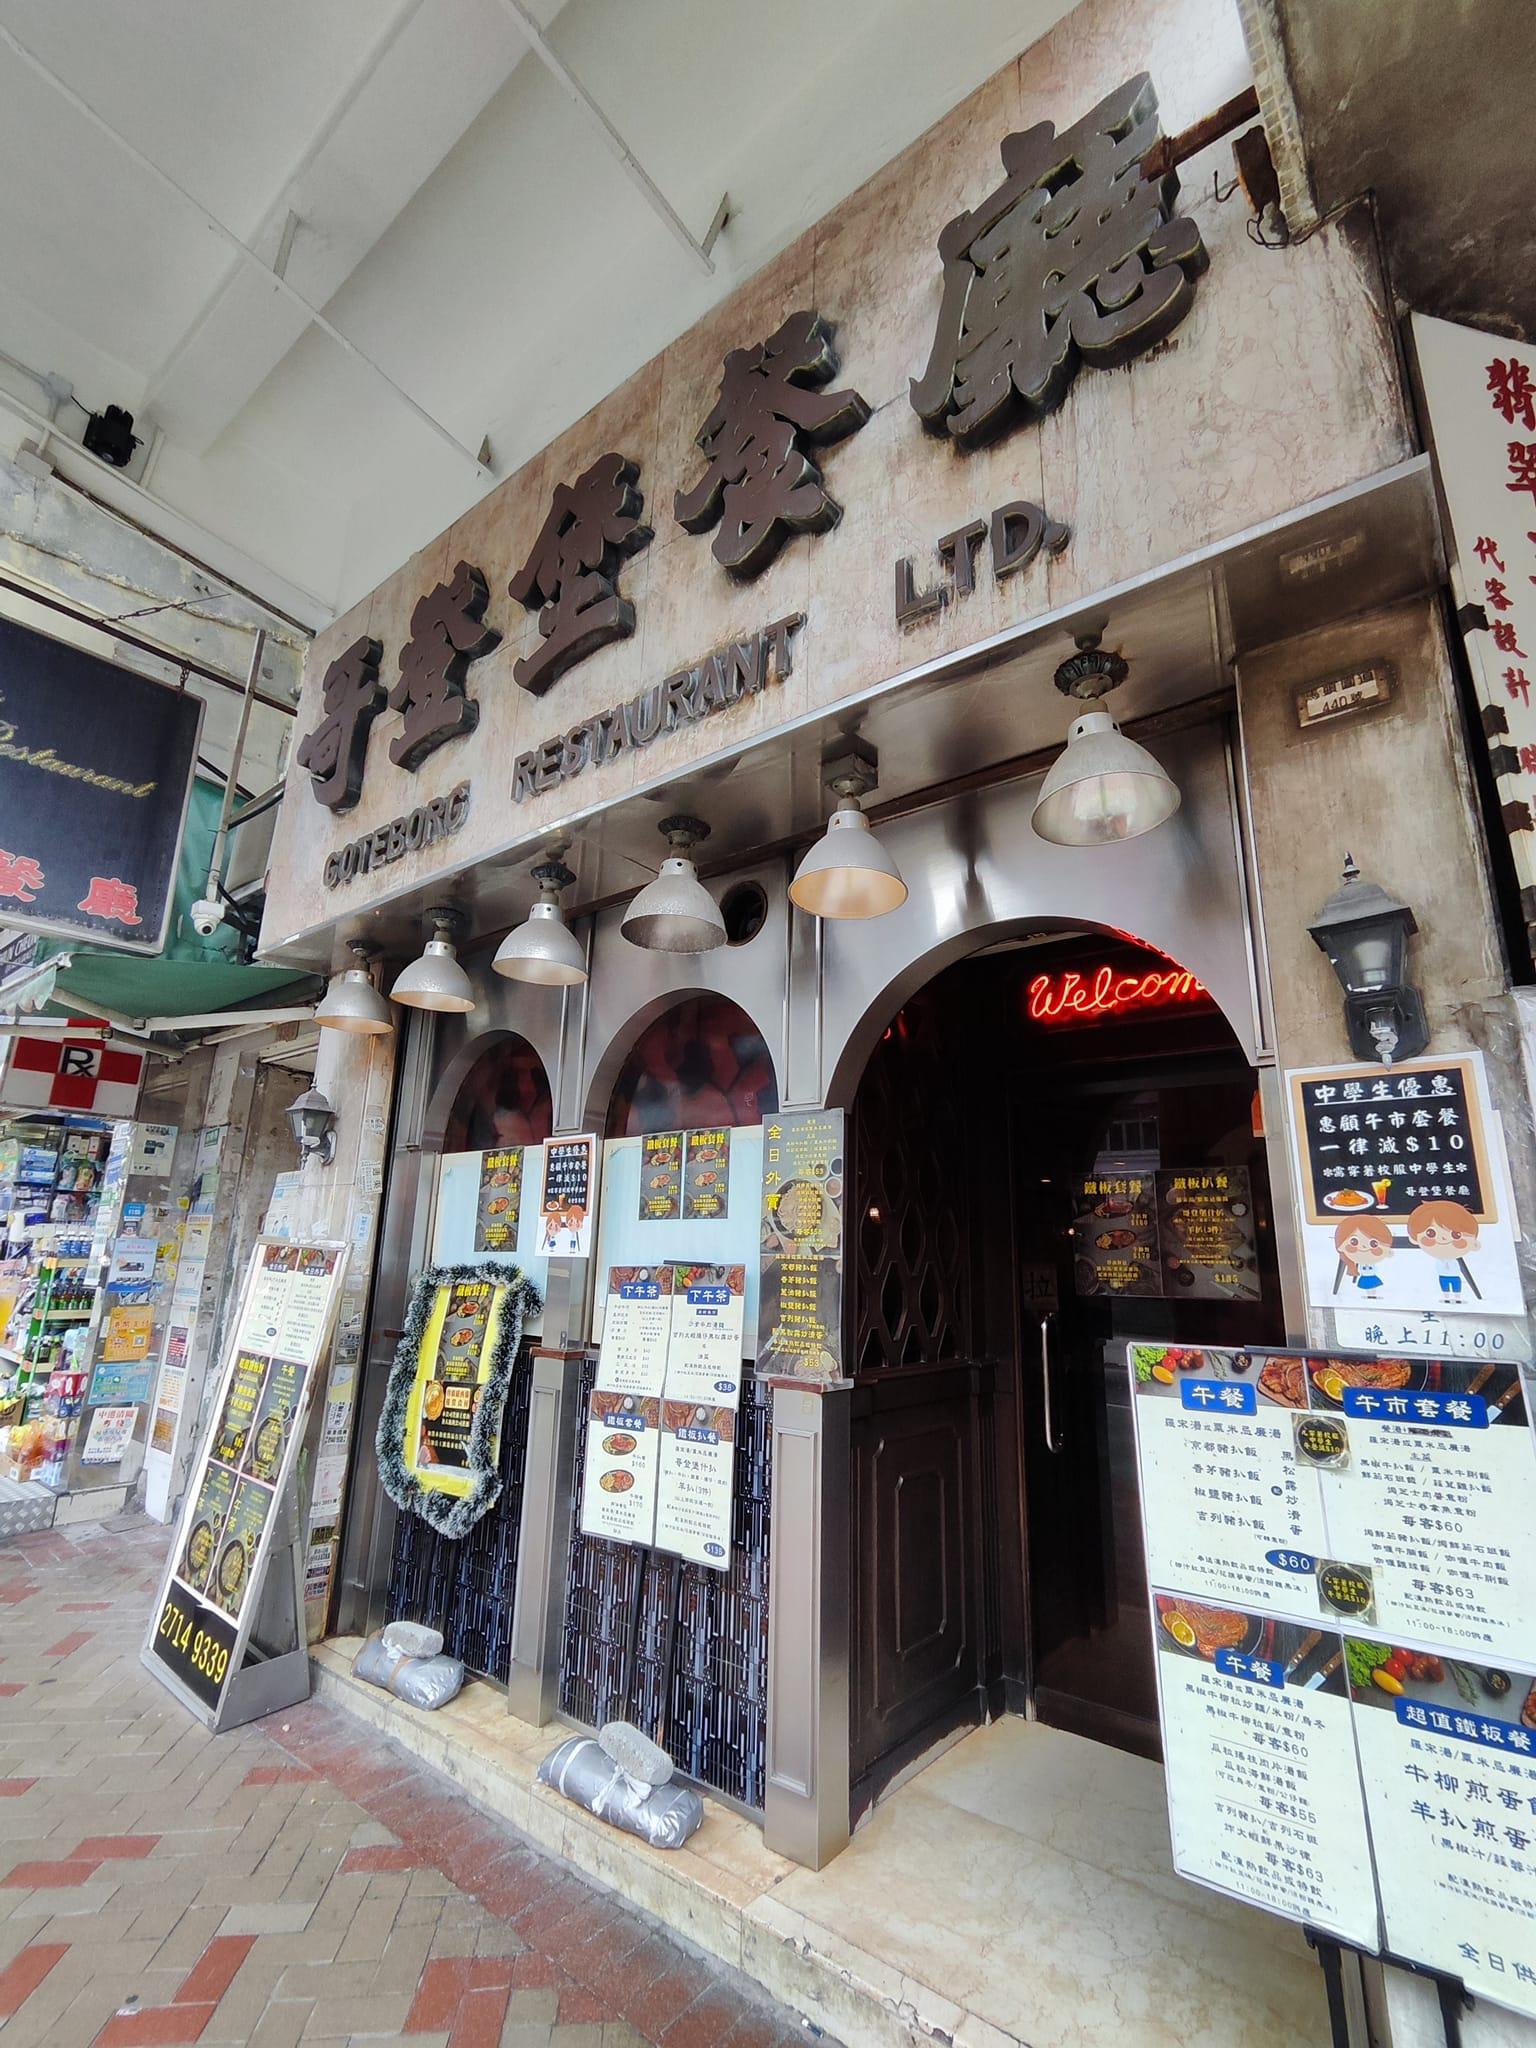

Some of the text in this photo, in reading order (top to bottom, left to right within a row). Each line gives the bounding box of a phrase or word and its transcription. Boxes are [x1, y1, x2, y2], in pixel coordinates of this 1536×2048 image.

[1473, 537, 1529, 708] 代客設計
[323, 780, 471, 890] GOTEBORG
[513, 612, 806, 802] RESTAURANT
[1031, 967, 1206, 1017] Welcom
[1314, 1075, 1455, 1103] 中學生優惠
[1319, 1107, 1460, 1133] 惠顧午市套餐
[1319, 1134, 1464, 1155] 一律減$10
[623, 1285, 660, 1298] 下午茶
[690, 1289, 729, 1303] 下午茶
[1364, 1327, 1505, 1350] 晚上11:00
[1191, 1385, 1244, 1408] 午餐
[1355, 1394, 1472, 1421] 午市套餐
[1190, 1439, 1258, 1457] 京都豬扒飯
[1192, 1464, 1261, 1481] 香茅豬扒飯
[1194, 1487, 1263, 1506] 椒鹽豬扒飯
[1196, 1510, 1266, 1531] 吉列豬扒飯
[1402, 1515, 1463, 1533] 每客$60
[1278, 1553, 1310, 1570] $60
[1411, 1579, 1475, 1599] 每客$63
[158, 1602, 229, 1685] 2714 9339
[1225, 1655, 1273, 1682] 午餐
[1406, 1705, 1532, 1751] 超值鐵板餐
[1252, 1732, 1309, 1758] 每客$60
[1259, 1796, 1317, 1824] 每客$55
[1411, 1799, 1536, 1852] 羊扒煎蛋
[1265, 1851, 1325, 1883] 每客$63
